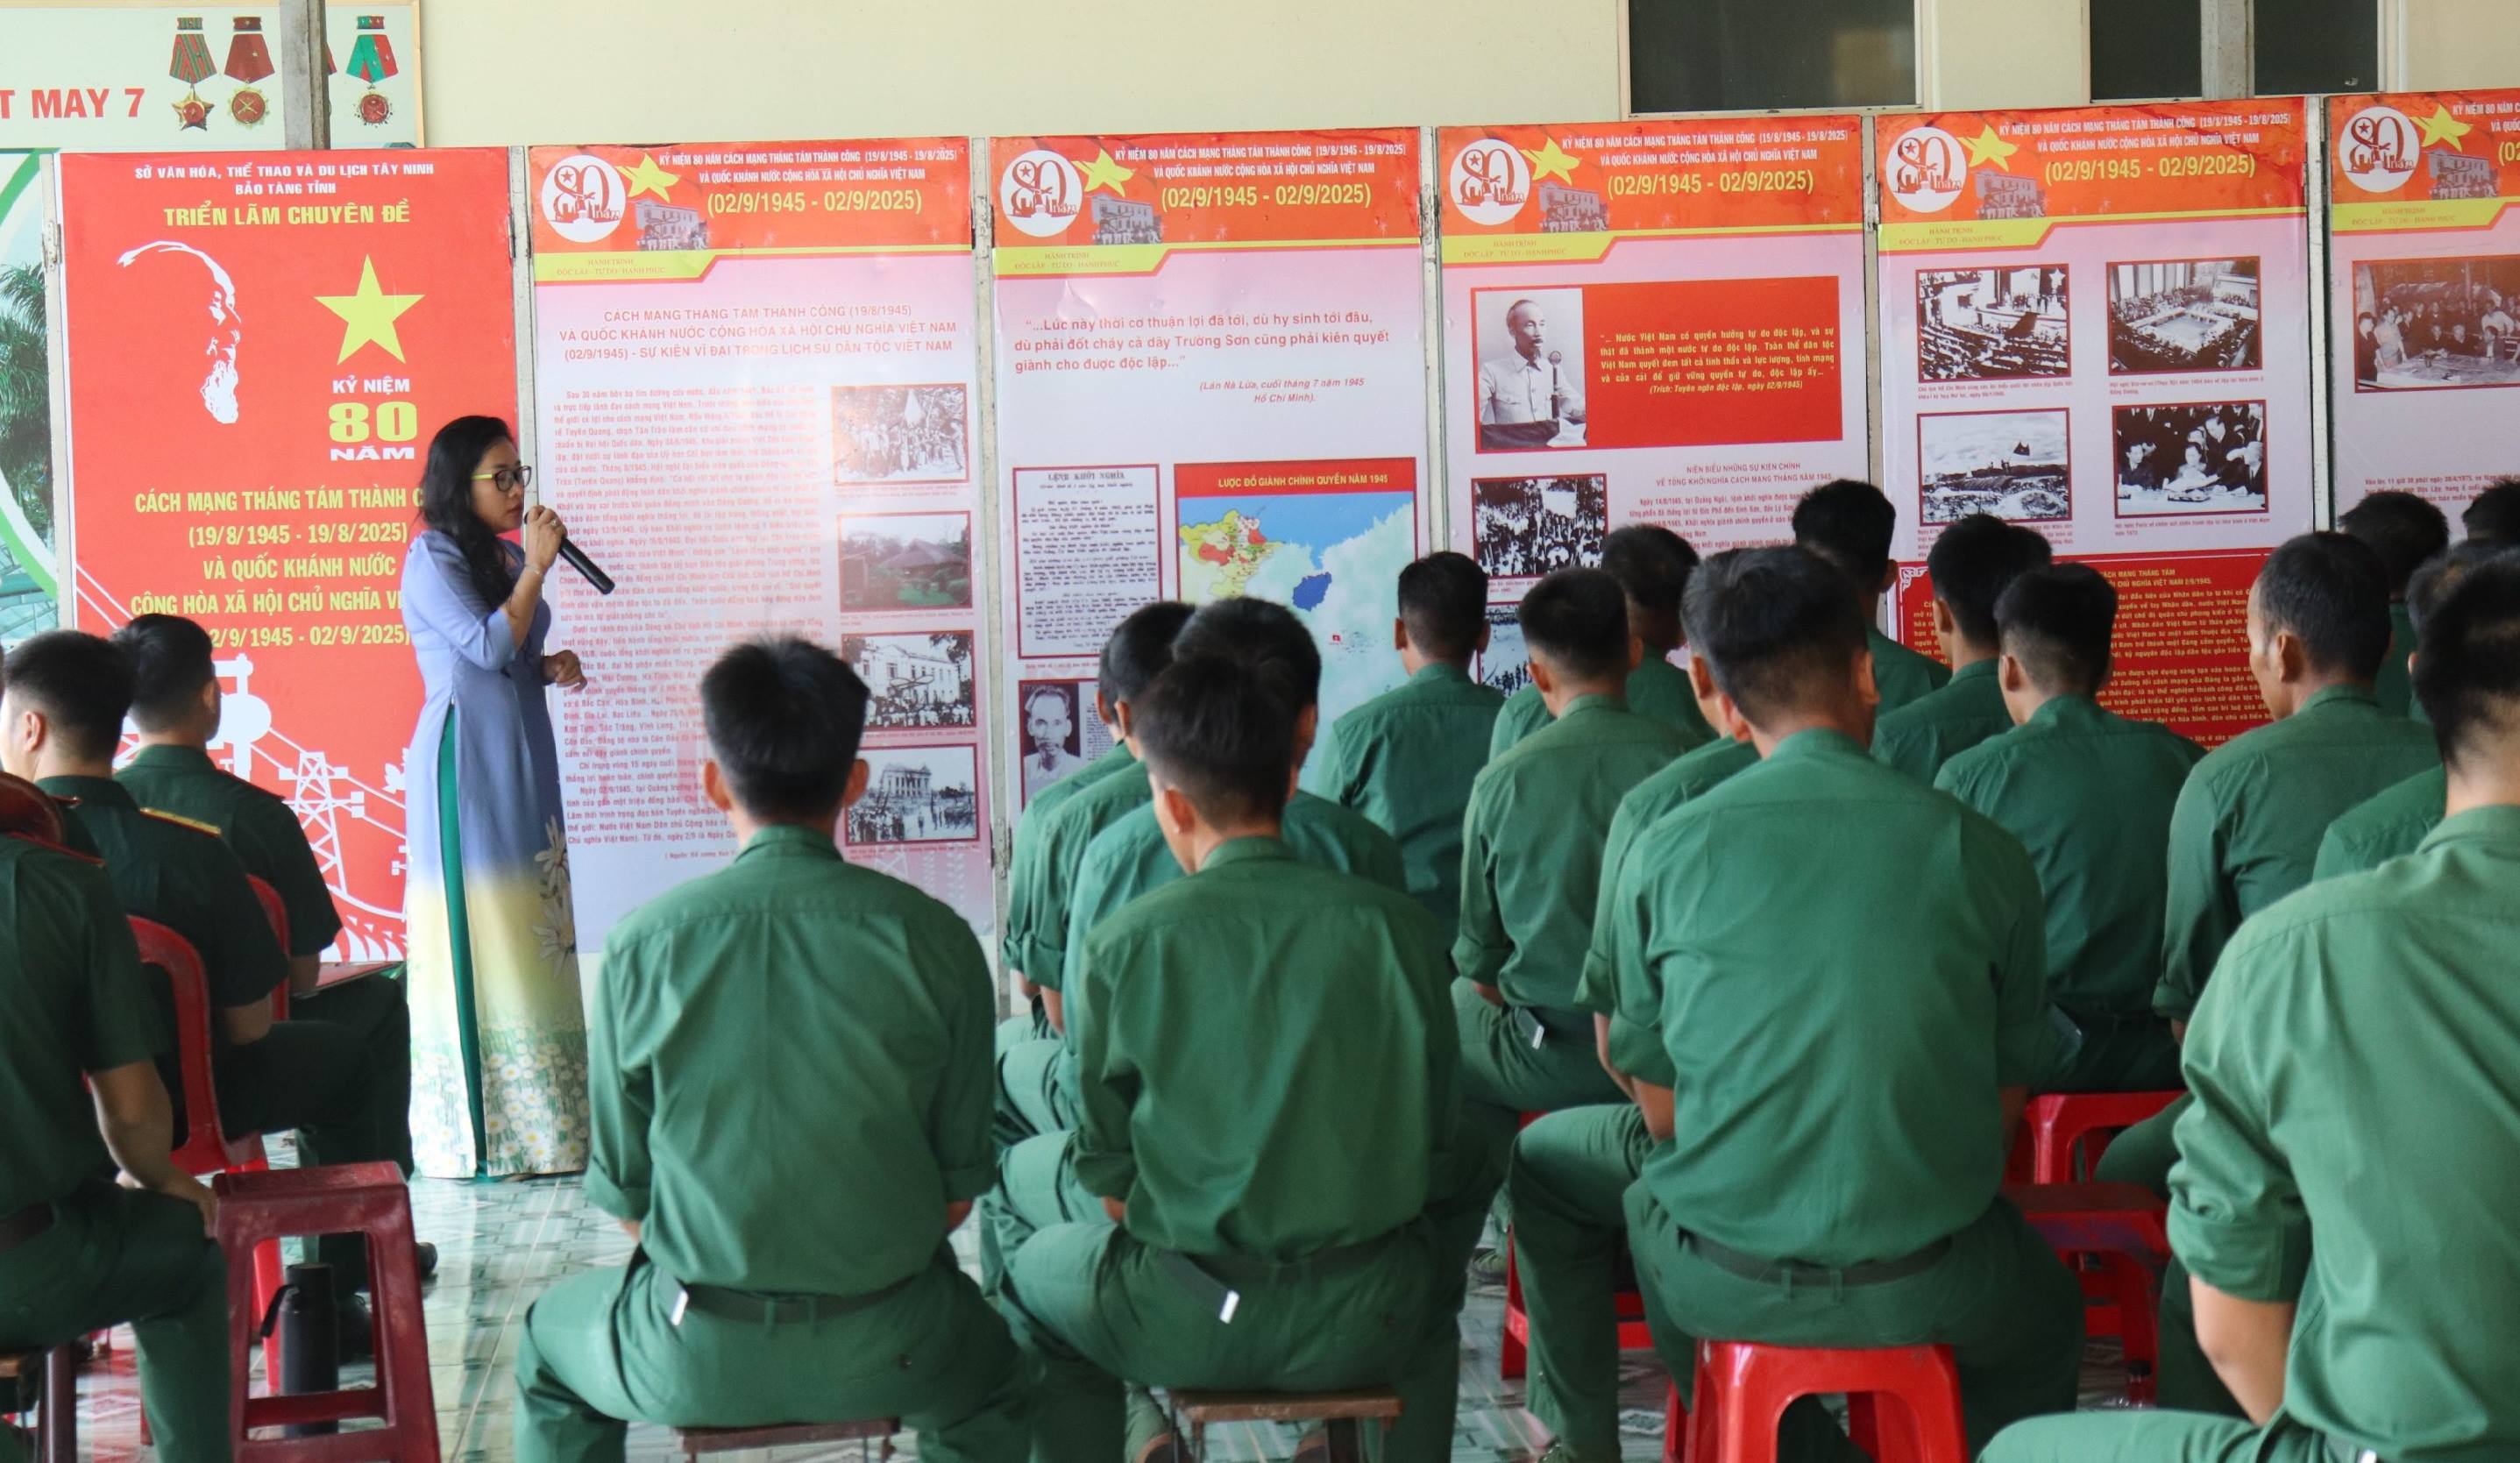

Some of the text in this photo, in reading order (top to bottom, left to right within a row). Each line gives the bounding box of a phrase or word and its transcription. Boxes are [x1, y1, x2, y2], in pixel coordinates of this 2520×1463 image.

[31, 88, 110, 118] MAY
[124, 88, 145, 117] 7
[135, 161, 434, 179] SỞ VĂN HÓA, THỂ THAO VÀ DU LỊCH TÂY NINH
[1608, 168, 1814, 200] (02/9/1945 02/9/2025)
[2045, 153, 2255, 186] (02/9/1945 02/9/2025)
[235, 180, 336, 195] BẢO TÀNG TỈNH
[1161, 182, 1371, 212] (02/9/1945 02/9/2025)
[163, 197, 409, 226] TRIỂN LÃM CHUYÊN ĐỀ
[707, 188, 921, 218] (02/9/1945 02/9/2025)
[1014, 339, 1031, 351] dù
[1034, 337, 1063, 352] phải
[1067, 337, 1088, 350] đốt
[1093, 337, 1123, 351] cháy
[1128, 338, 1142, 348] cả
[1175, 336, 1221, 349] Trường
[1225, 334, 1250, 346] Sơn
[1254, 334, 1286, 347] cũng
[1289, 332, 1318, 347] phải
[1322, 331, 1349, 343] kiên
[1353, 329, 1388, 345] quyết
[1015, 359, 1051, 374] giành
[1055, 359, 1080, 370] cho
[1083, 358, 1115, 370] được
[1119, 357, 1143, 369] độc
[332, 374, 409, 394] KỶ NIỆM
[328, 401, 417, 442] 80
[330, 445, 415, 460] NĂM
[135, 487, 181, 513] CÁCH
[187, 491, 237, 515] MẠNG
[241, 486, 300, 510] THÁNG
[304, 485, 343, 508] TÁM
[348, 483, 406, 508] THÀNH
[202, 551, 395, 582] VÀ QUỐC KHÁNH NƯỚC
[182, 589, 218, 614] HÒA
[224, 588, 247, 614] XÃ
[252, 588, 283, 617] HỘI
[287, 585, 323, 612] CHỦ
[330, 586, 381, 610] NGHĨA
